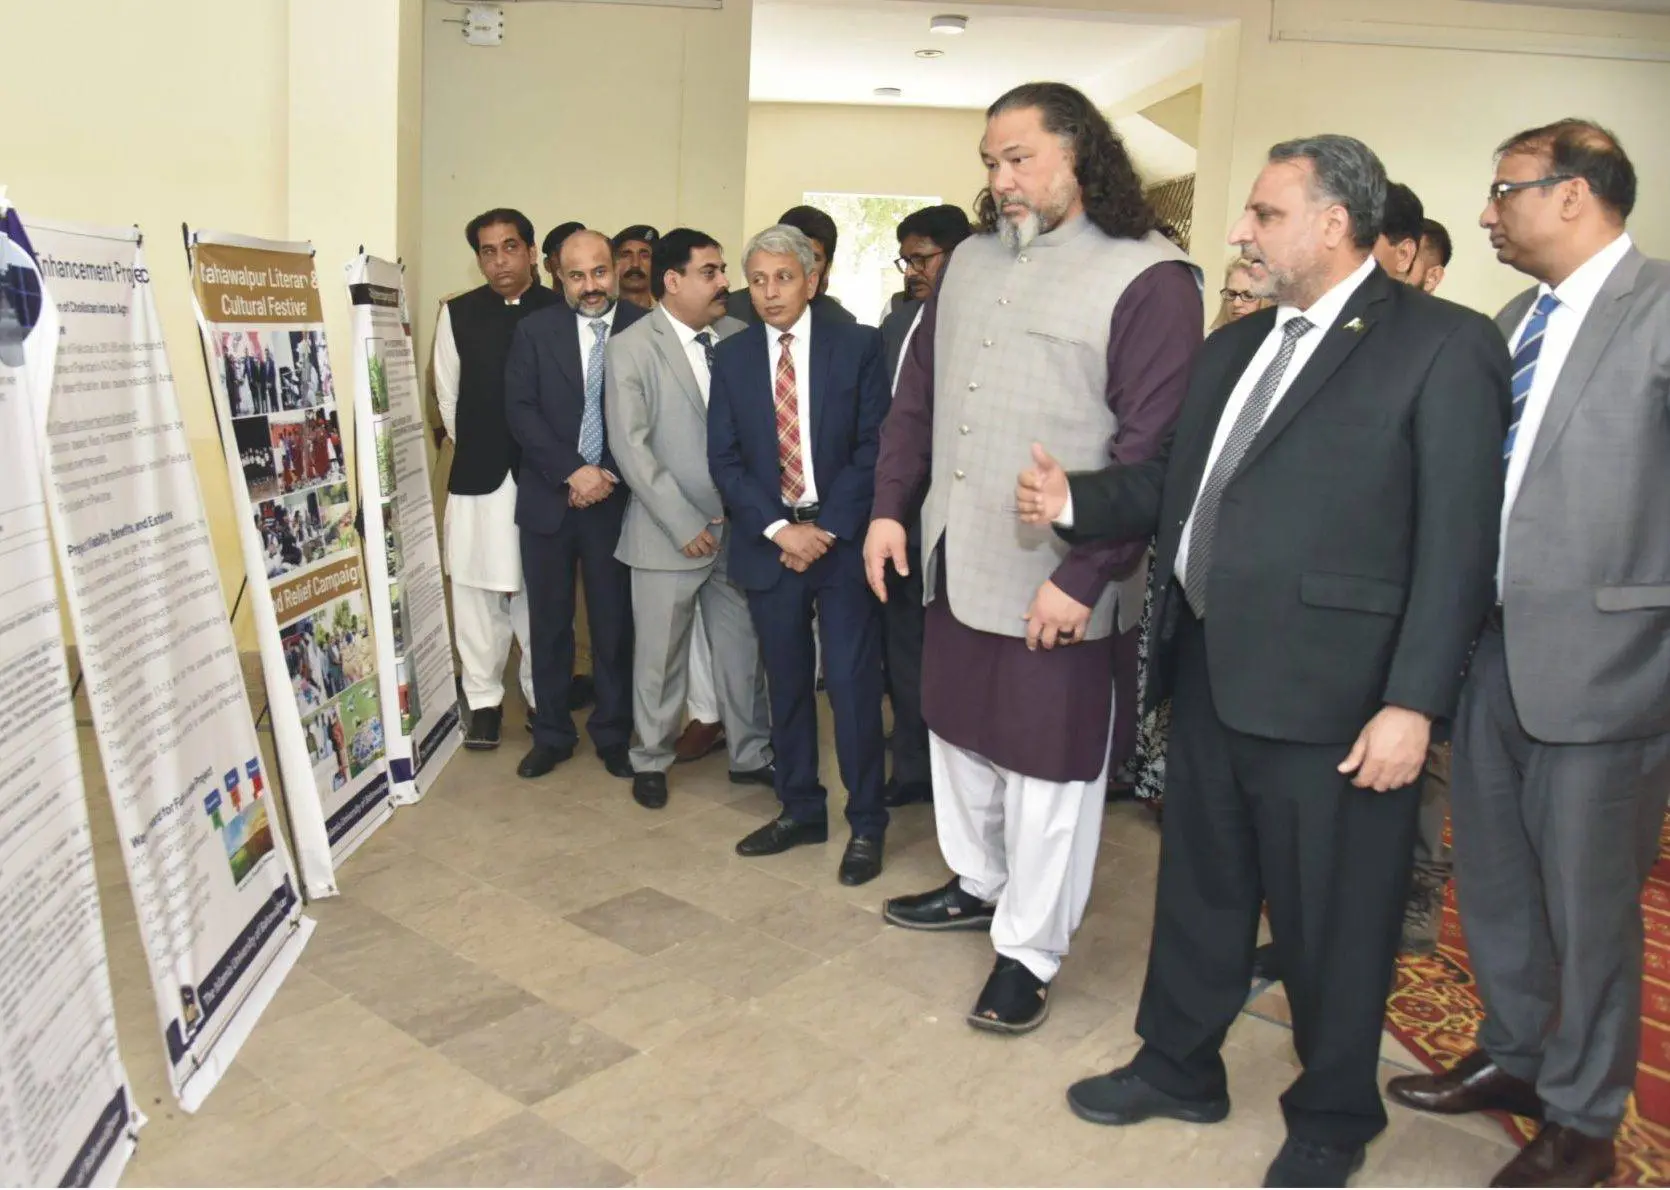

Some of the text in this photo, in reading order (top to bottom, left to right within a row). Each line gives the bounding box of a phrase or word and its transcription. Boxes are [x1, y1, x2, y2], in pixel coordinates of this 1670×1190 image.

[114, 261, 150, 288] Projec
[221, 294, 308, 316] Cultural Festiva
[283, 581, 312, 609] Relief
